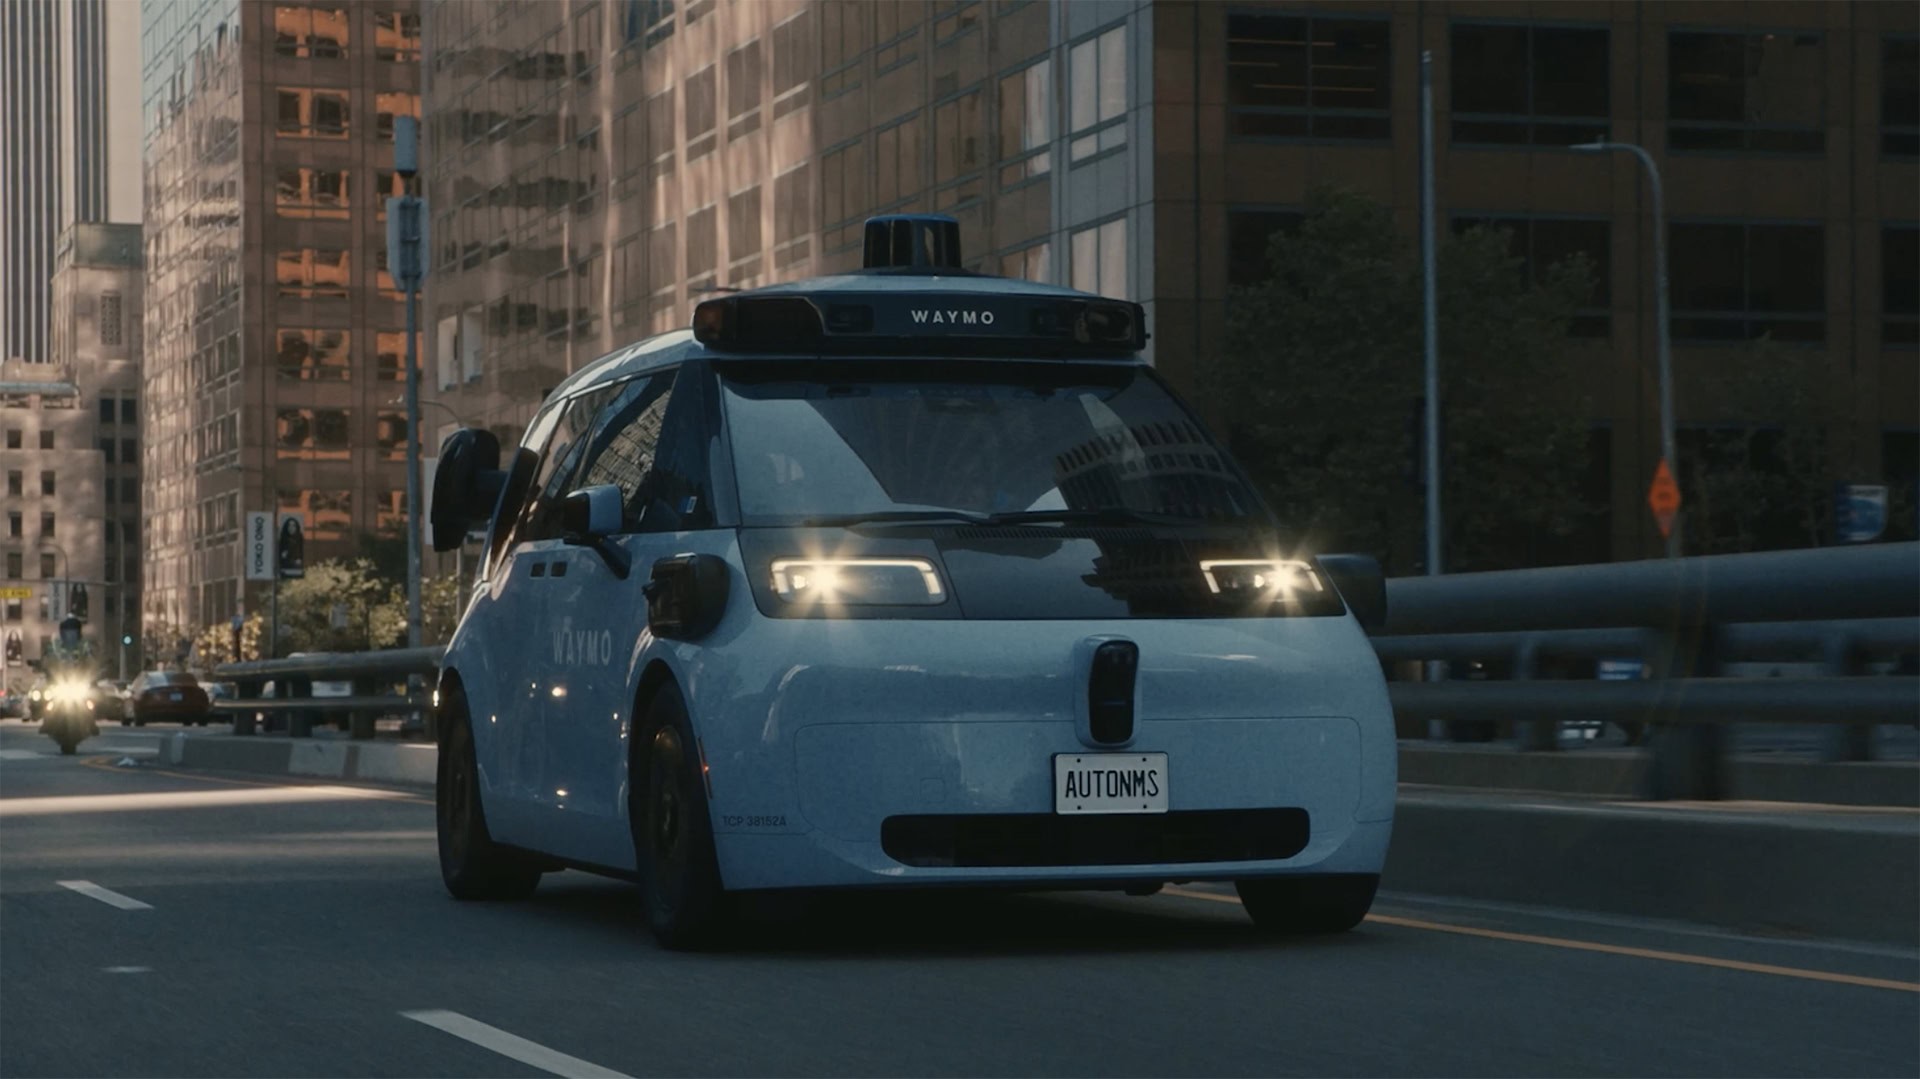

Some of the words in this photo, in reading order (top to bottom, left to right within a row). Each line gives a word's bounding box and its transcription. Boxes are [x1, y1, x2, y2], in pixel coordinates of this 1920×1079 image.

[911, 309, 994, 325] WAYMO
[254, 516, 264, 541] ONO
[254, 543, 264, 576] YOKO
[553, 629, 611, 667] WAYMO
[1065, 769, 1159, 798] AUTONMS
[722, 815, 743, 827] TCP
